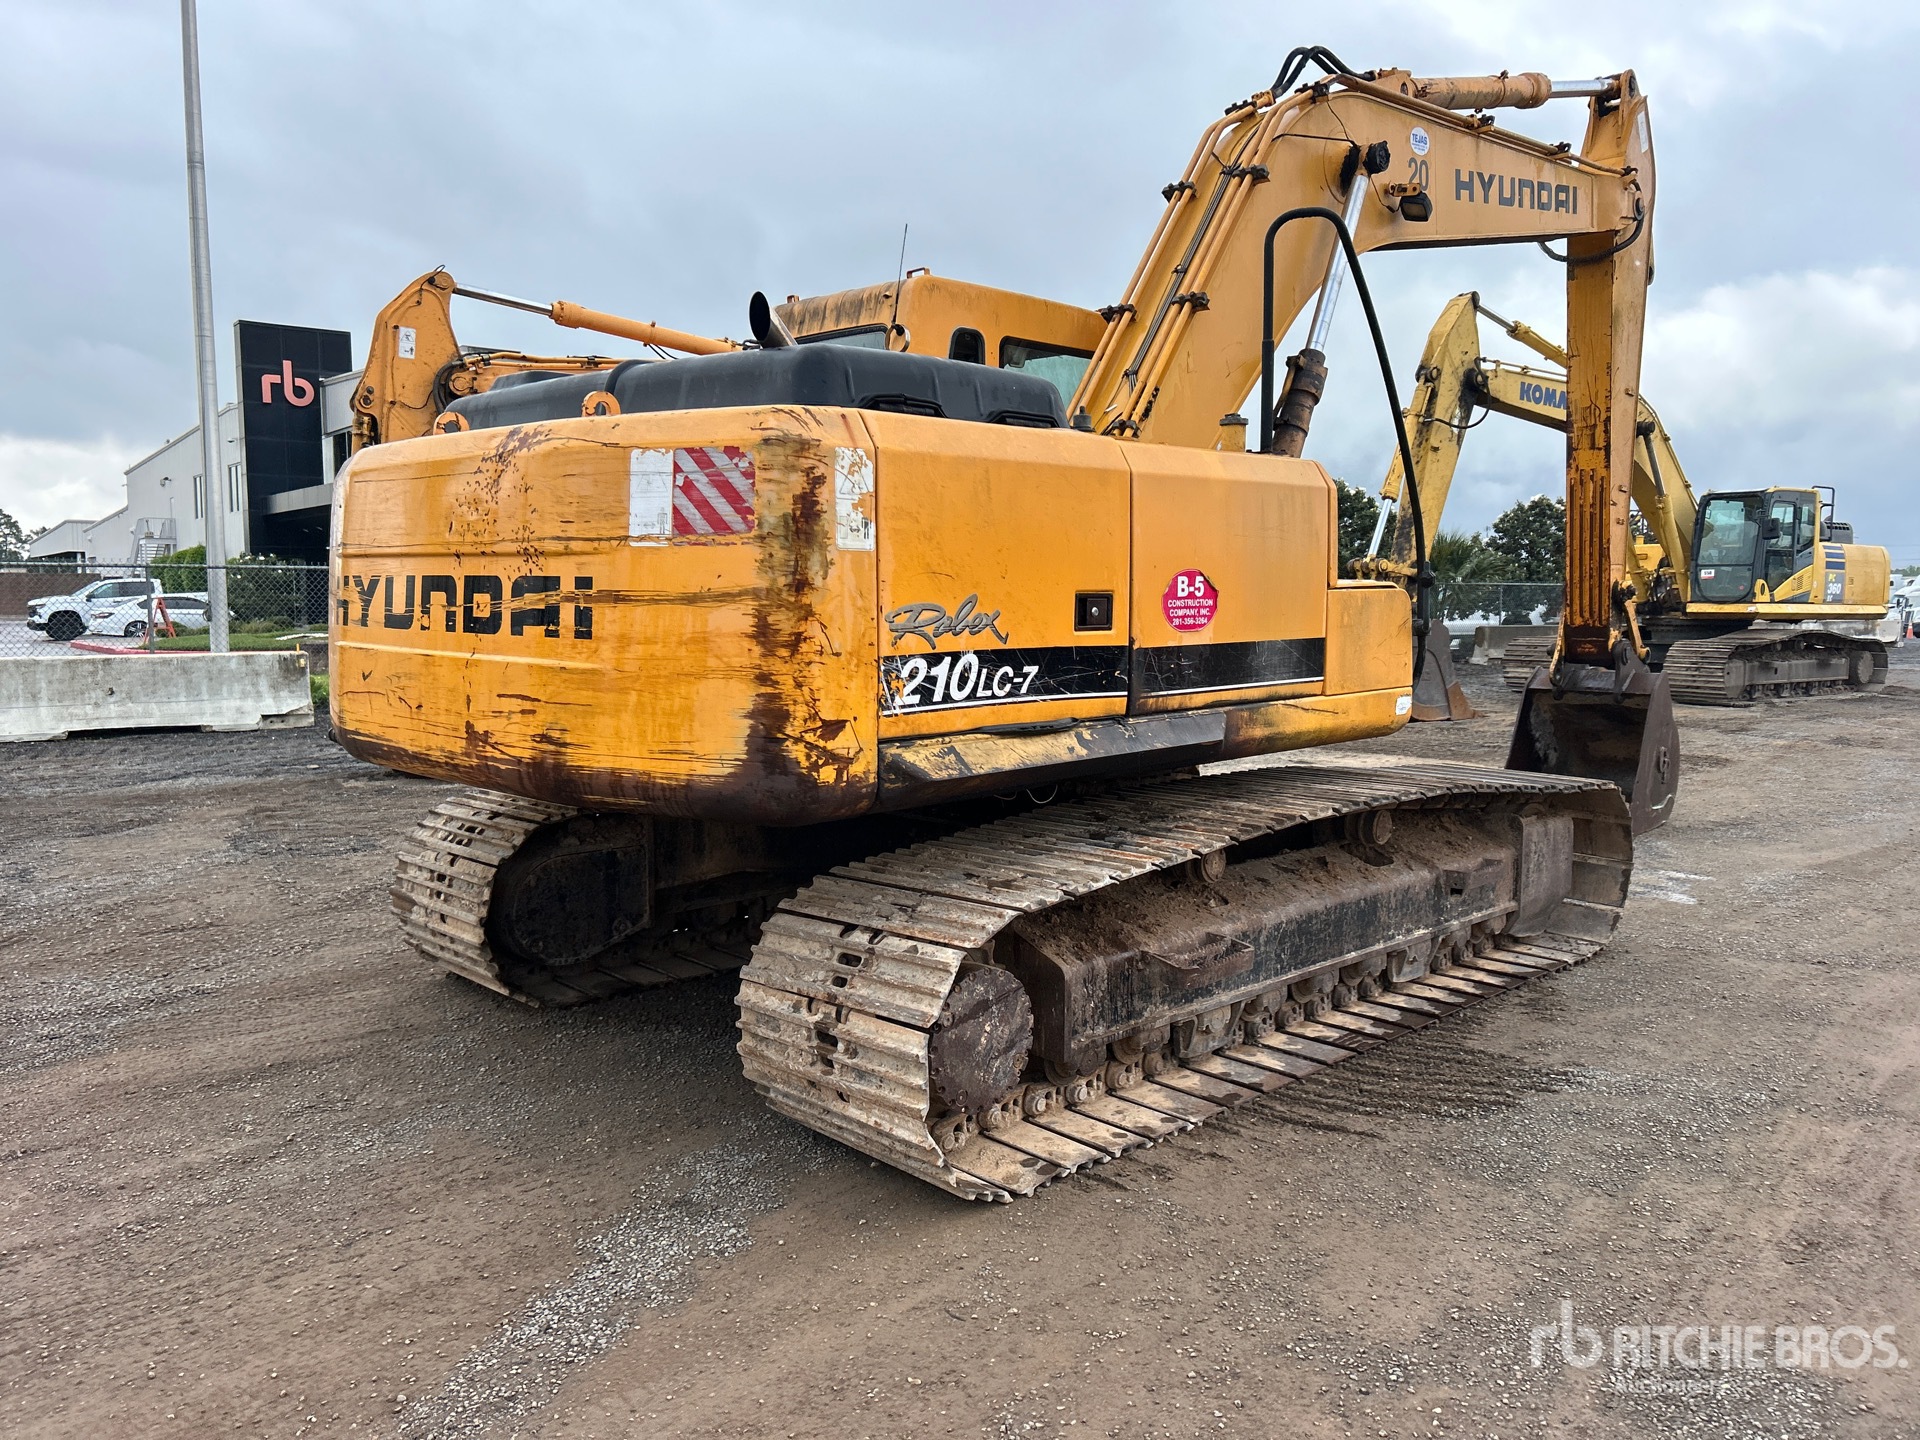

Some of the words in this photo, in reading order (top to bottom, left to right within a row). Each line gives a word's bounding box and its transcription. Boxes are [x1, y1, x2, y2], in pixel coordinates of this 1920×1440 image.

[1411, 133, 1428, 146] TEJAS
[1408, 157, 1429, 191] 20
[1455, 168, 1578, 215] HYUNDAI
[261, 360, 315, 407] rb
[1177, 575, 1205, 597] B-5
[1827, 583, 1842, 595] 360
[337, 575, 593, 640] HYUNDAI
[1167, 598, 1214, 608] CONSTRUCTION
[1169, 608, 1199, 617] COMPANY,
[1200, 607, 1211, 616] INC.
[884, 593, 1010, 650] Robex
